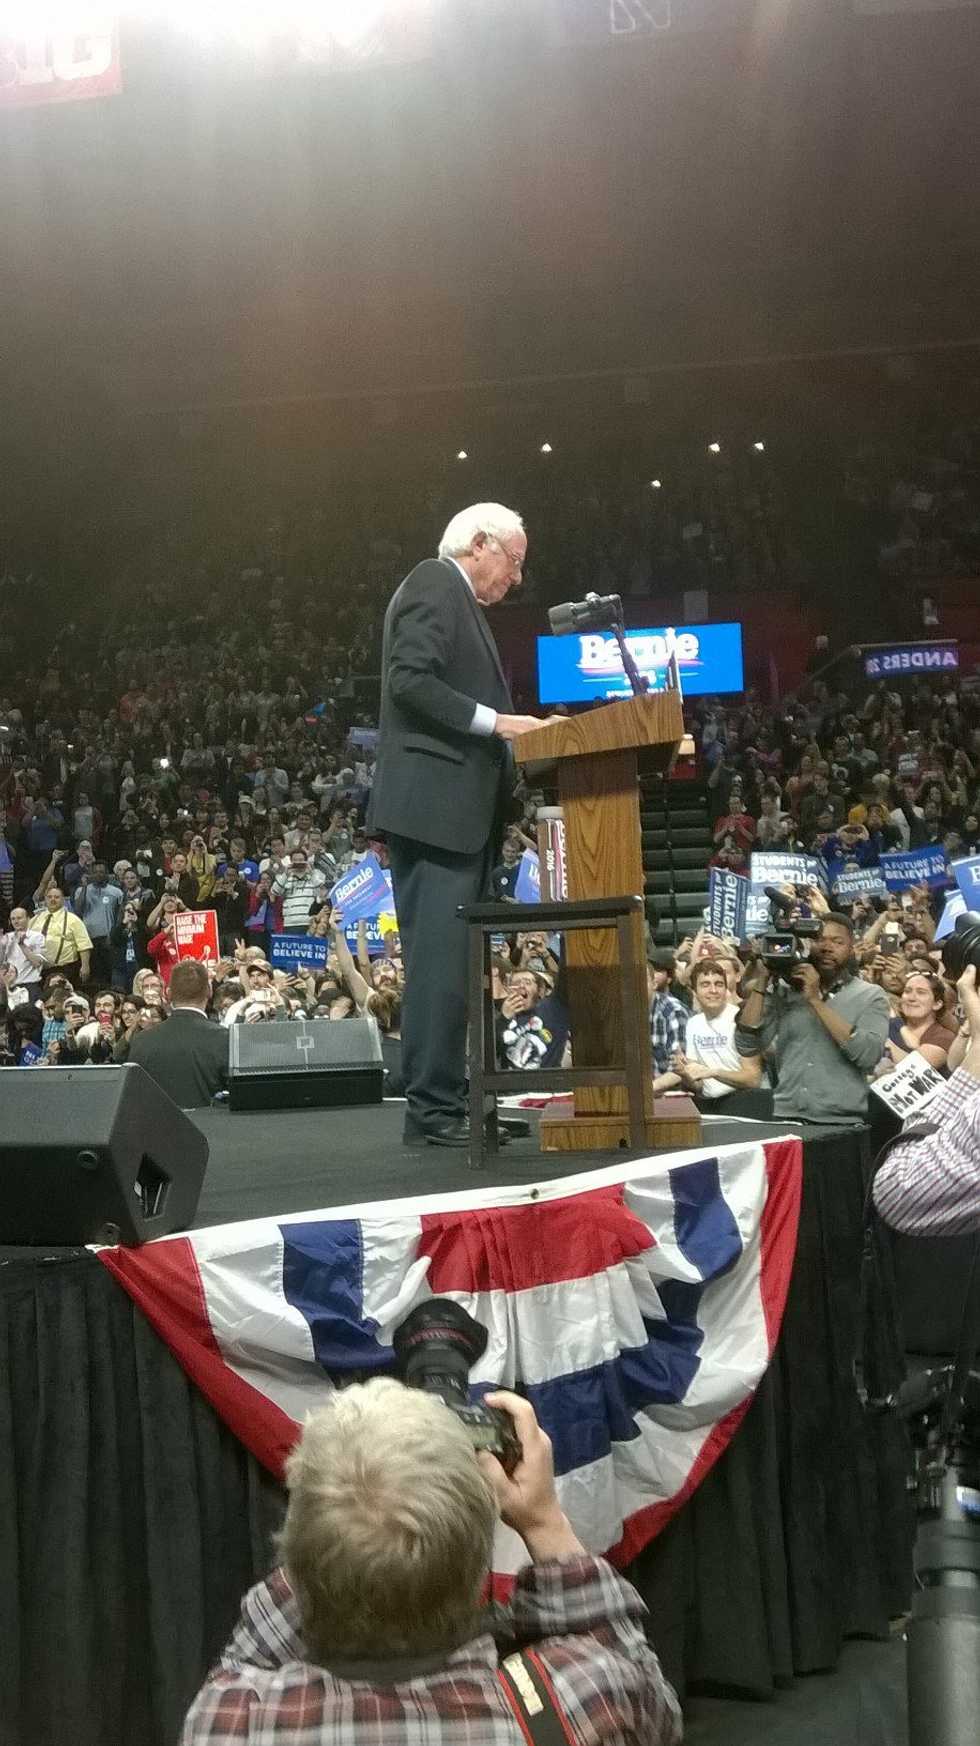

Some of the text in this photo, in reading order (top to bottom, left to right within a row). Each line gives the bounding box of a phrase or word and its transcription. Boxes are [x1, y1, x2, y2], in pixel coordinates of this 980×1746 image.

[752, 866, 818, 887] Bernie
[838, 877, 883, 893] Bernie
[281, 942, 314, 951] FUTURE
[314, 944, 326, 953] TO
[273, 949, 326, 960] BELIEVE IN
